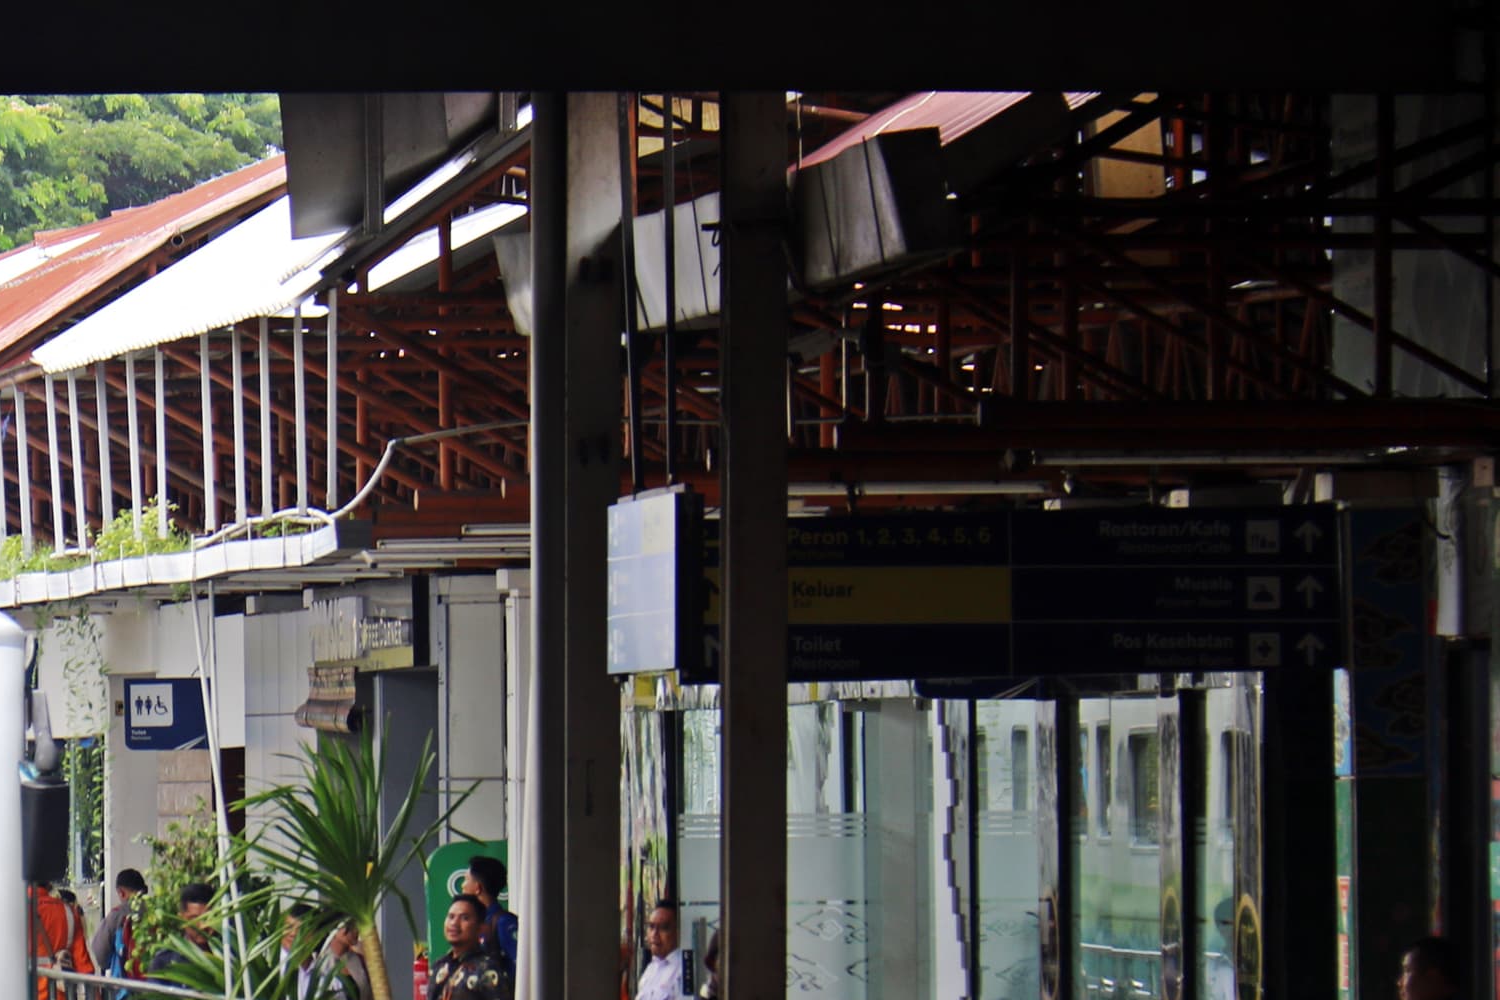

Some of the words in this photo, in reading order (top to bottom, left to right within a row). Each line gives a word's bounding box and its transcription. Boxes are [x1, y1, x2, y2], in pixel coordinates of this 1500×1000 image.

[788, 527, 849, 545] Peron
[1099, 520, 1231, 537] Restoran/Kafe
[792, 580, 855, 598] Keluar
[792, 635, 842, 652] Toilet
